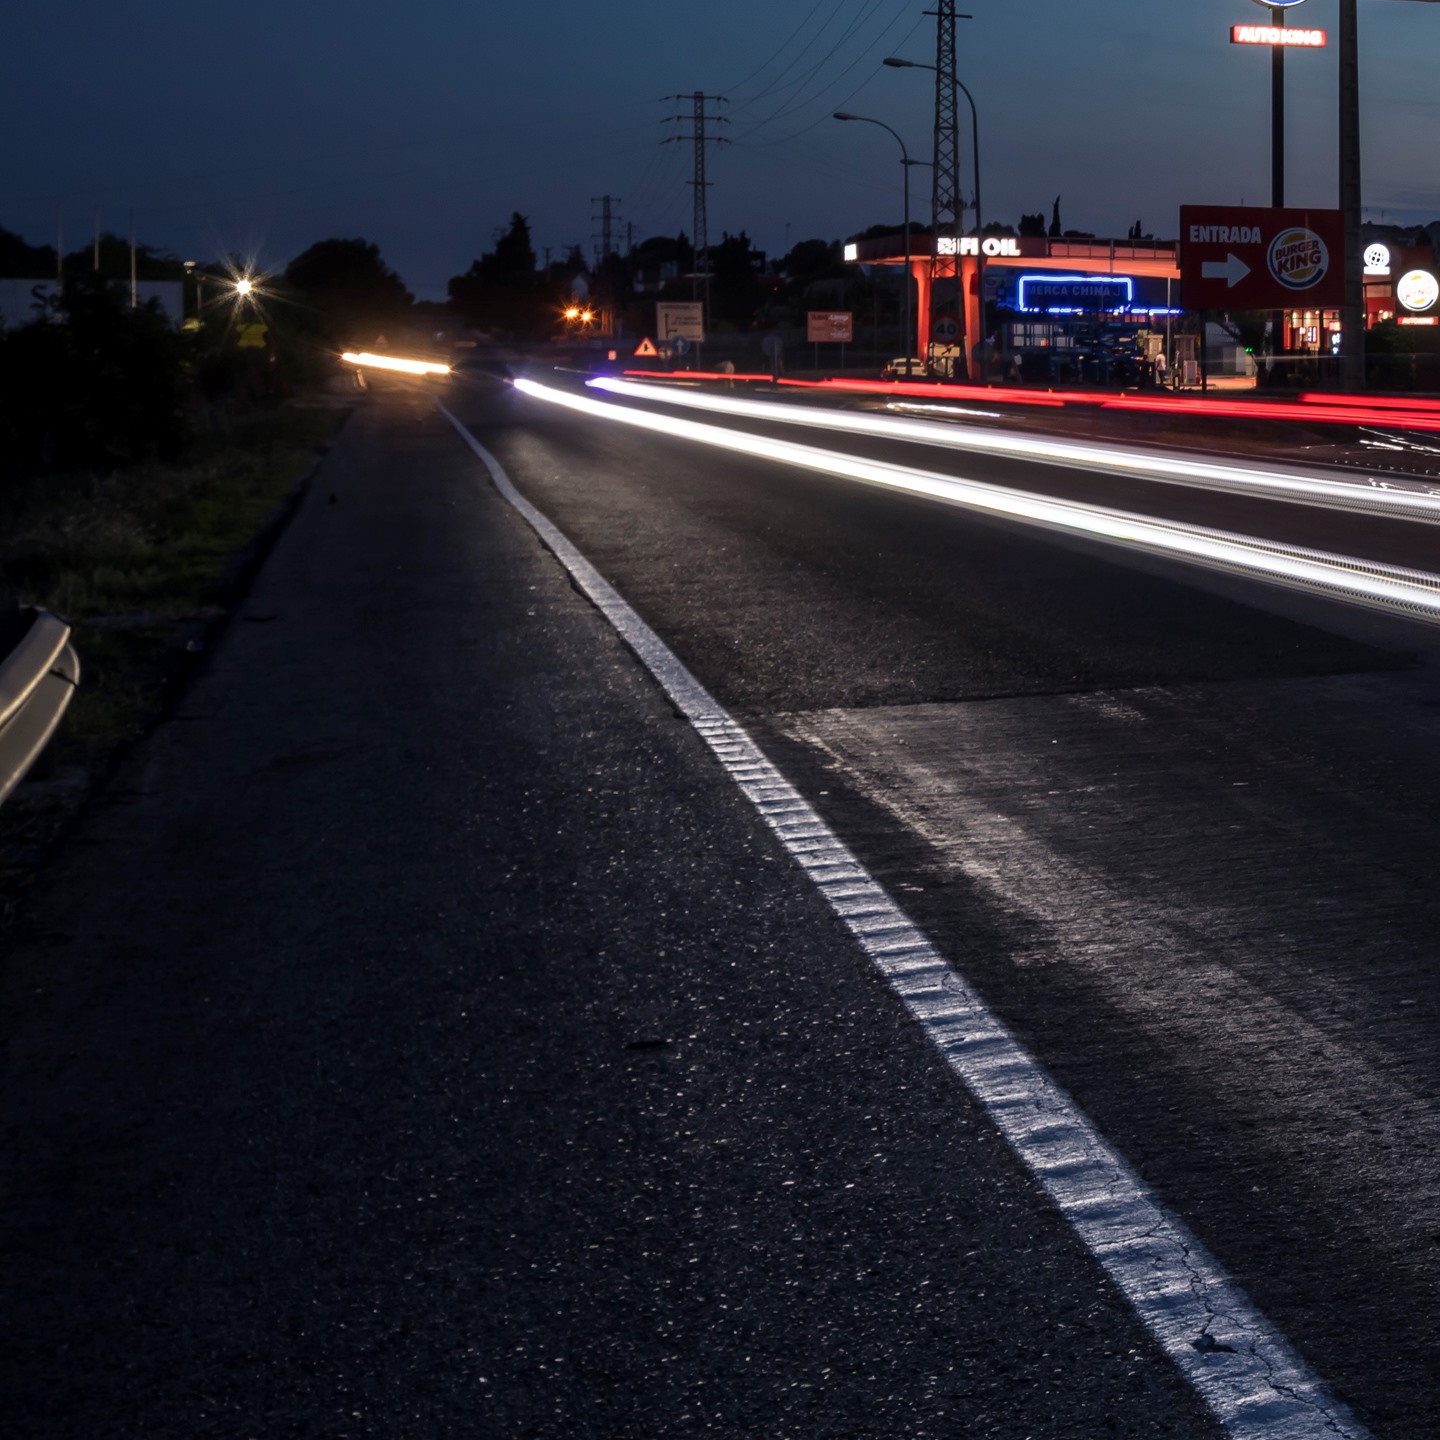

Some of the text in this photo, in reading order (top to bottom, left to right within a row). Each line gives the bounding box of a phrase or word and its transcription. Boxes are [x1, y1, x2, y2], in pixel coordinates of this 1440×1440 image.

[1190, 225, 1261, 244] ENTRADA
[982, 238, 1021, 256] OIL
[1275, 238, 1319, 258] BURGER
[1277, 250, 1322, 276] KING
[1028, 285, 1068, 296] MERCA
[1072, 286, 1110, 296] CHINA
[936, 323, 956, 335] 40
